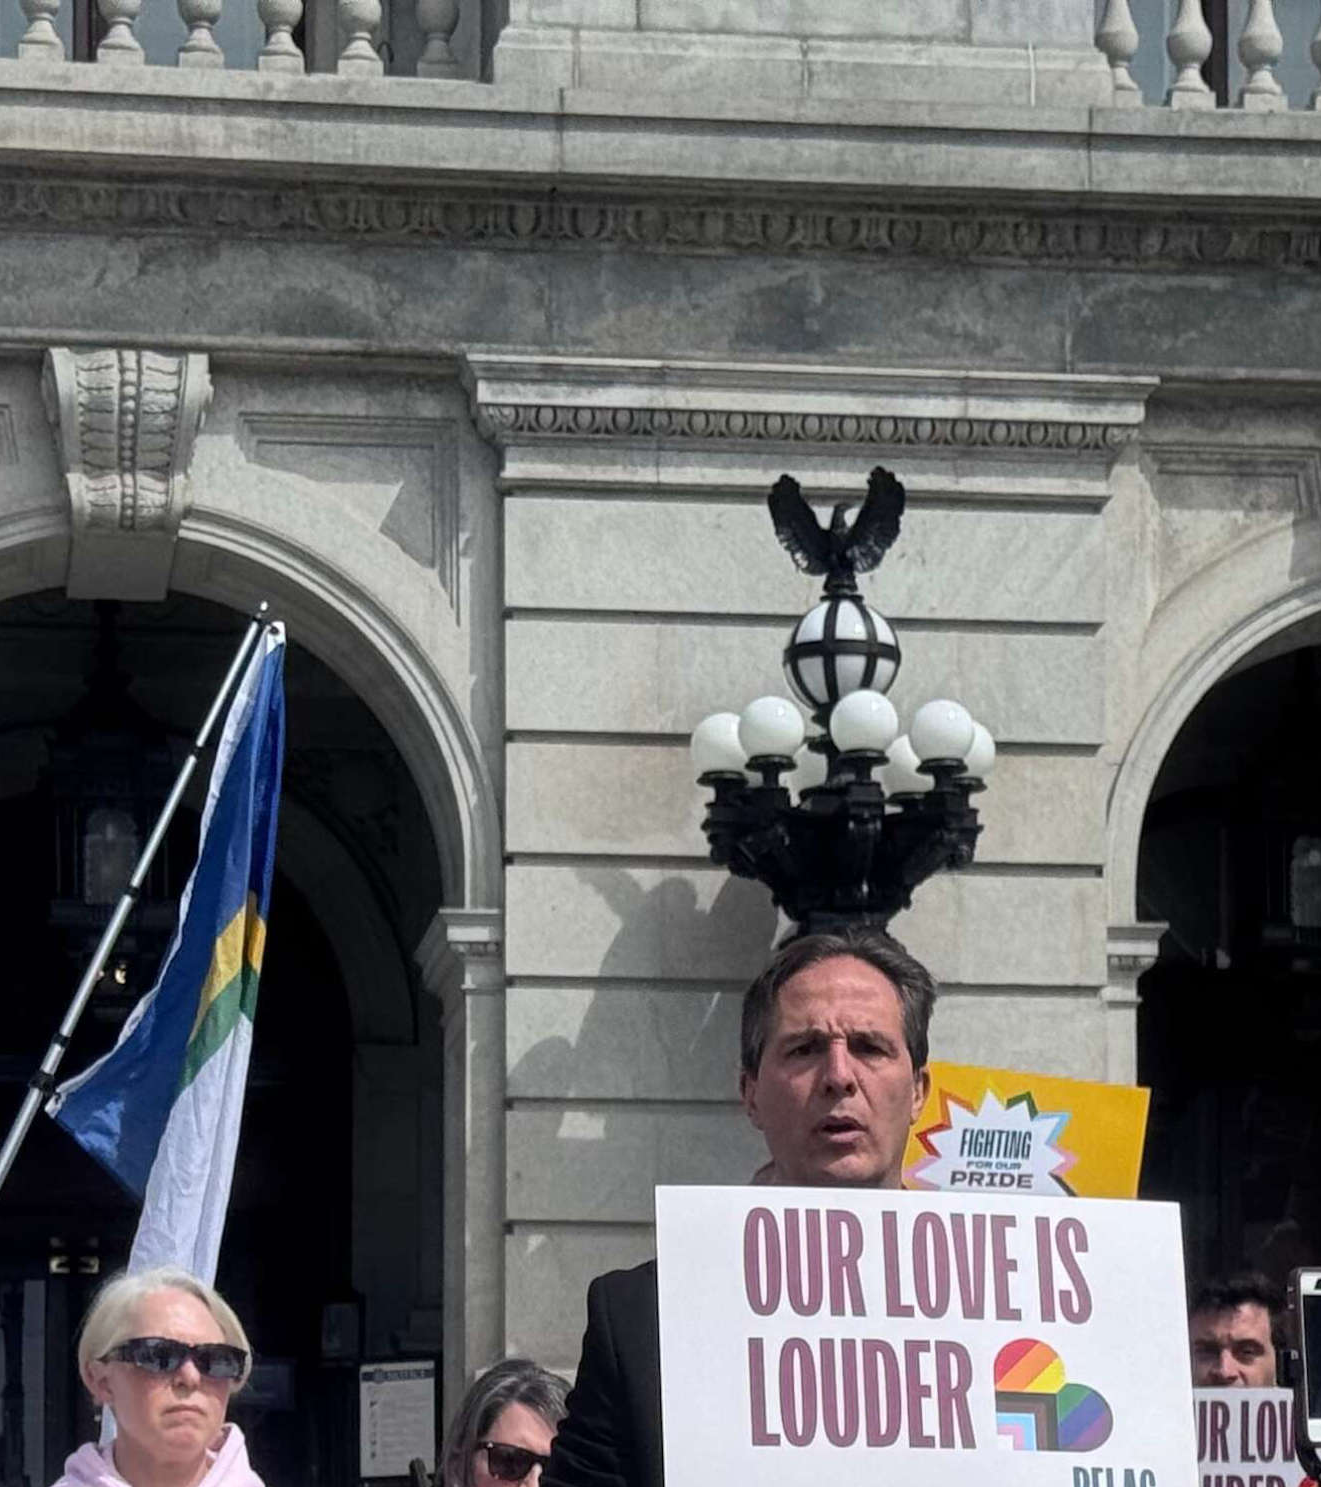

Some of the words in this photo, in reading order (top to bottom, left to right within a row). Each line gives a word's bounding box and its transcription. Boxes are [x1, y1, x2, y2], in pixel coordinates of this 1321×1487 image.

[960, 1128, 1032, 1160] FIGHTING
[967, 1161, 994, 1169] FOR
[995, 1162, 1022, 1170] OUR
[949, 1170, 1033, 1189] PRIDE
[743, 1206, 867, 1318] OUR
[881, 1210, 1023, 1323] LOVE
[1035, 1216, 1093, 1325] IS
[748, 1336, 977, 1450] LOUDER
[1240, 1399, 1296, 1464] LOV
